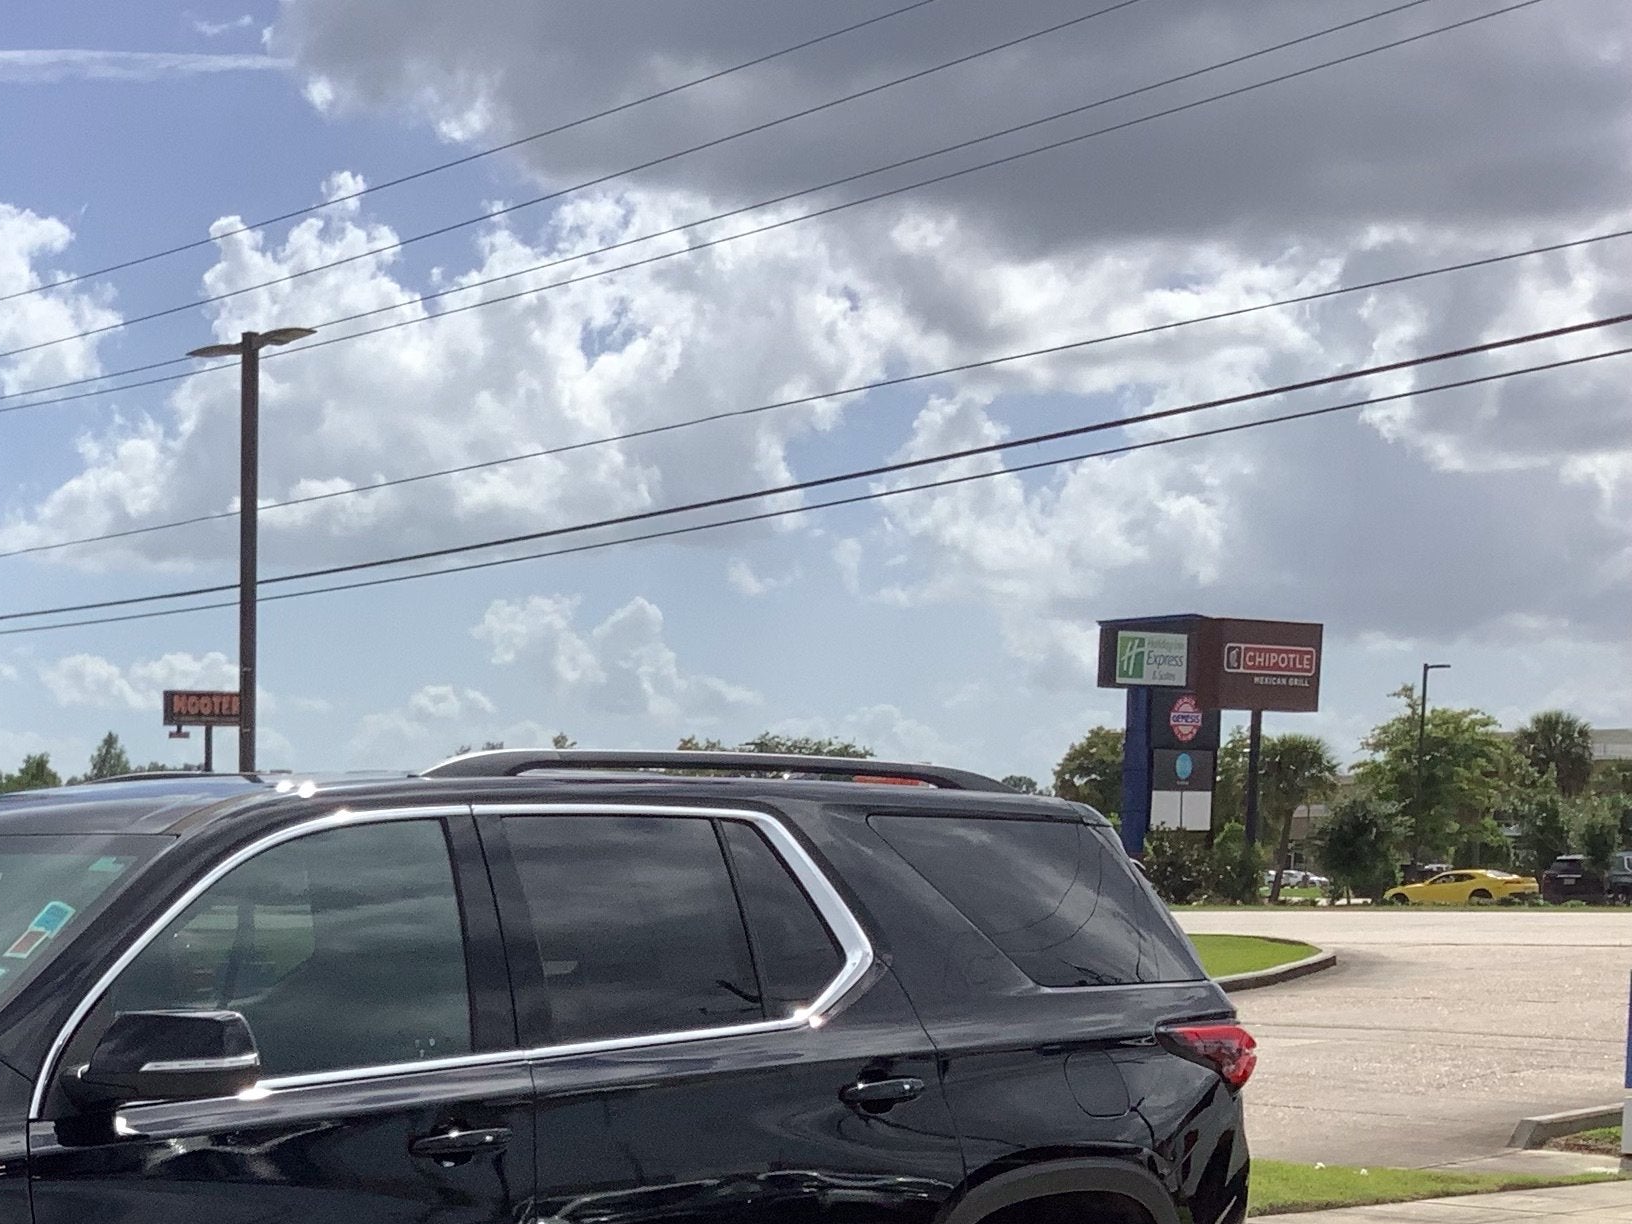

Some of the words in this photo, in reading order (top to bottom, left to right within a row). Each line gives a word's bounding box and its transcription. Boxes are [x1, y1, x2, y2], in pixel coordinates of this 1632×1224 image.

[1146, 650, 1184, 669] Express
[1245, 651, 1312, 669] CHIPOTLE
[1254, 676, 1286, 686] MEXICAN
[1288, 677, 1310, 687] GRILL
[173, 694, 240, 715] HOOTER
